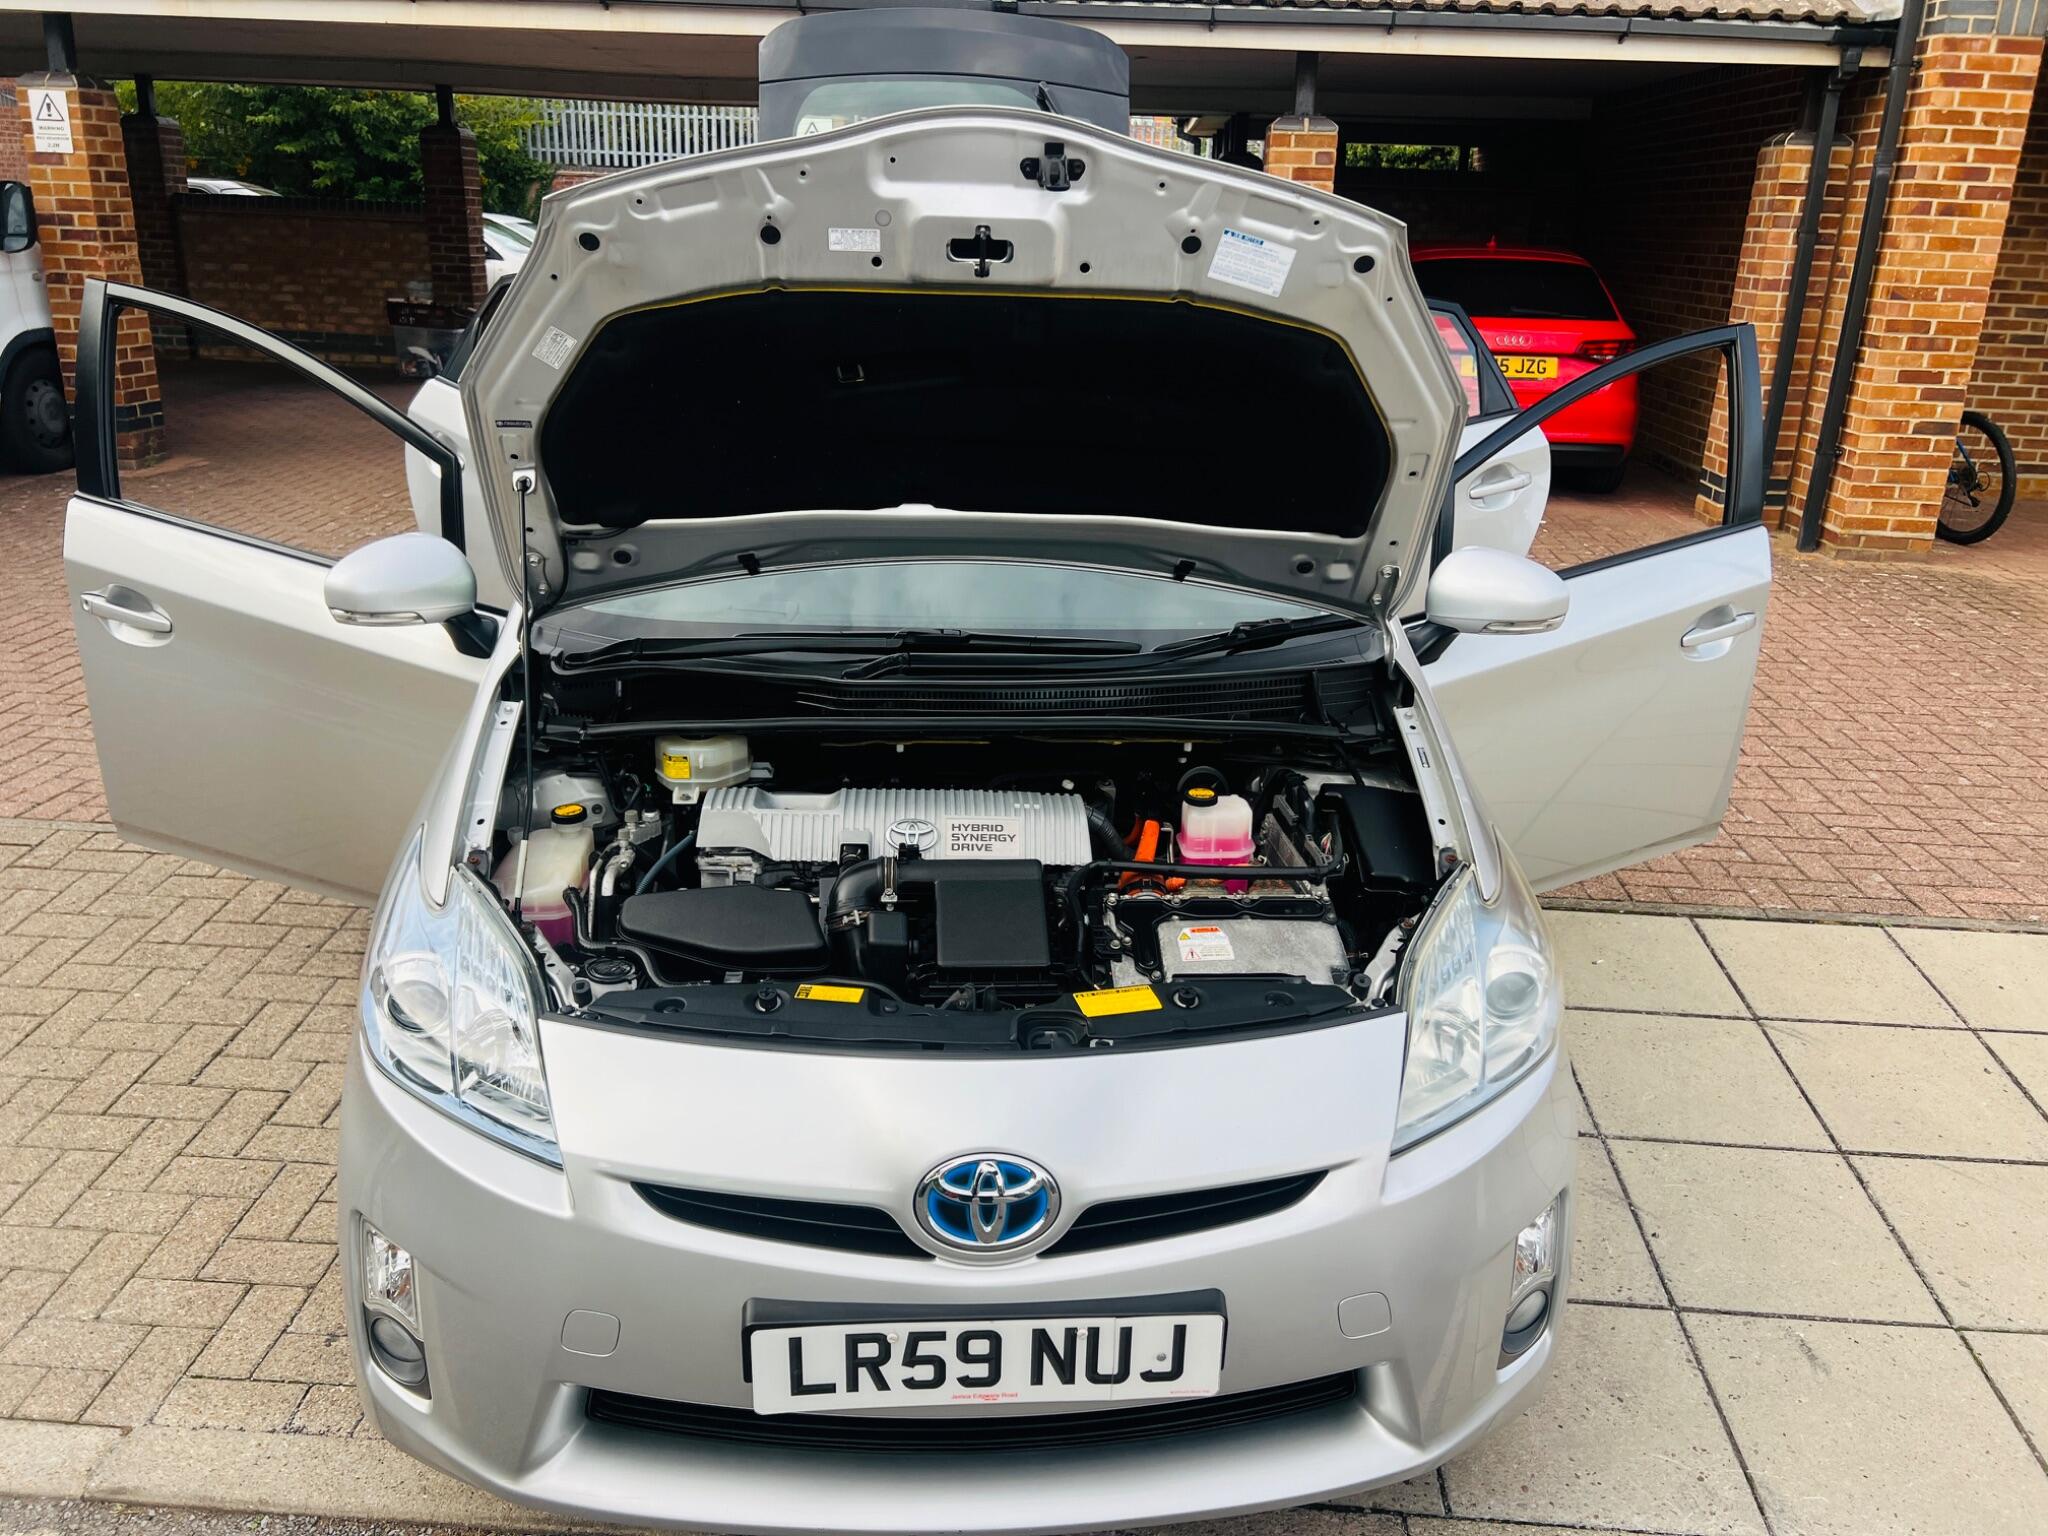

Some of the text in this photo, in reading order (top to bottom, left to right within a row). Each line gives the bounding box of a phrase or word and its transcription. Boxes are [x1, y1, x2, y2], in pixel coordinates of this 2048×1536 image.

[1515, 359, 1547, 374] JZG
[951, 823, 1004, 832] HYBRID
[951, 833, 1017, 842] SYNERGY
[951, 843, 993, 852] DRIVE
[788, 1324, 1187, 1396] LR59 NUJ
